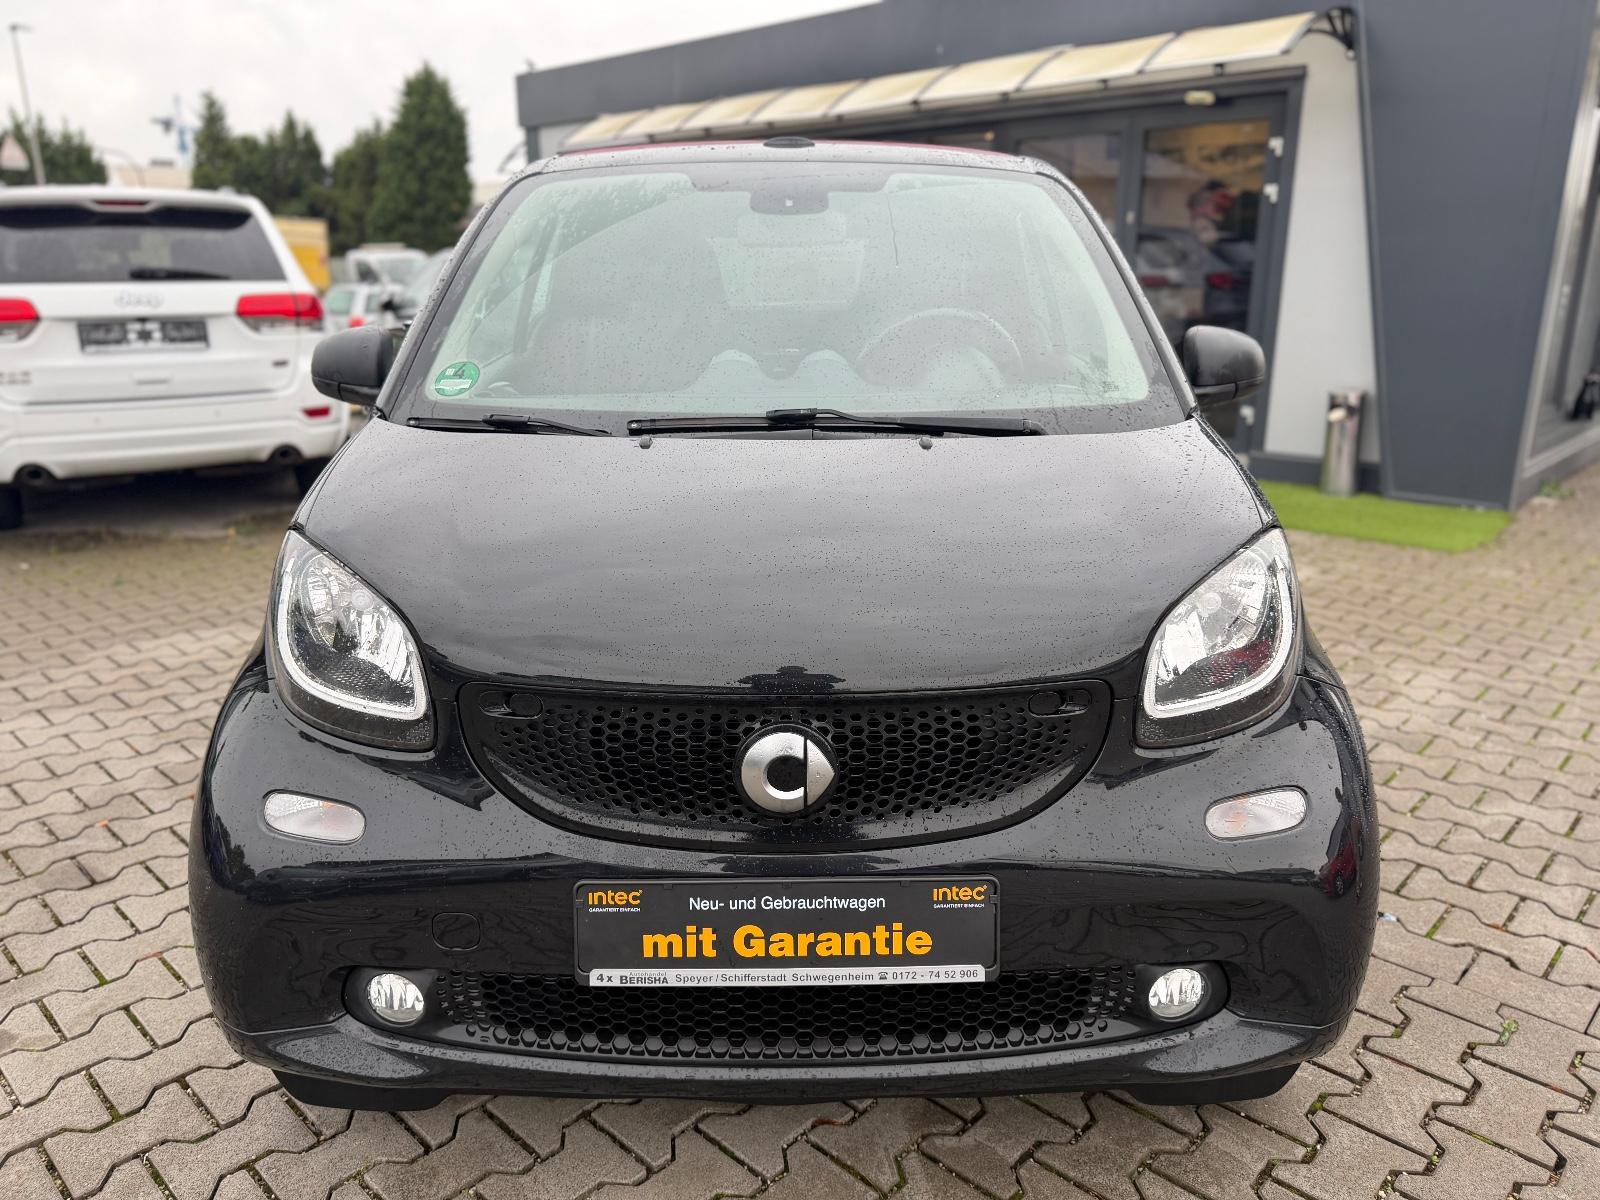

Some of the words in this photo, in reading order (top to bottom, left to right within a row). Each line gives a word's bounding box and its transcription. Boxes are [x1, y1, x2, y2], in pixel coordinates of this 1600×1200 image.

[689, 897, 724, 911] Neu-
[729, 896, 757, 910] und
[761, 894, 886, 912] Gebrauchtwagen
[642, 925, 717, 958] mit
[732, 922, 933, 958] Garantie
[619, 975, 669, 985] BERISHA
[792, 972, 874, 983] Schwegenheim
[892, 971, 917, 980] 0172
[928, 970, 940, 979] 74
[944, 969, 956, 978] 52
[959, 969, 978, 978] 906
